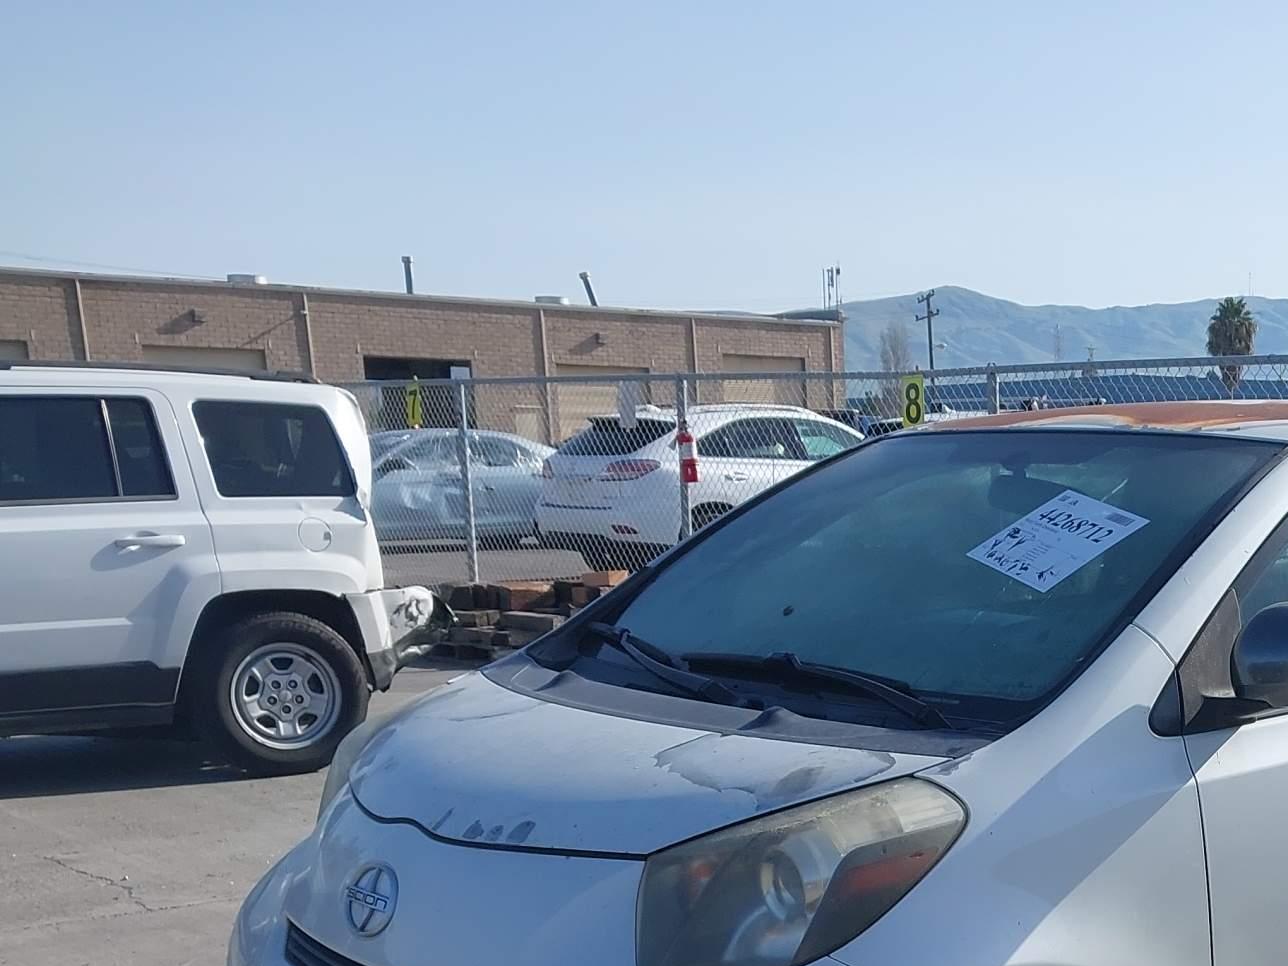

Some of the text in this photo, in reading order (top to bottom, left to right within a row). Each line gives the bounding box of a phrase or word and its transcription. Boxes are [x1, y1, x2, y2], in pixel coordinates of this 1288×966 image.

[408, 389, 418, 420] 7
[905, 382, 922, 425] 8
[1038, 508, 1114, 544] 44268712
